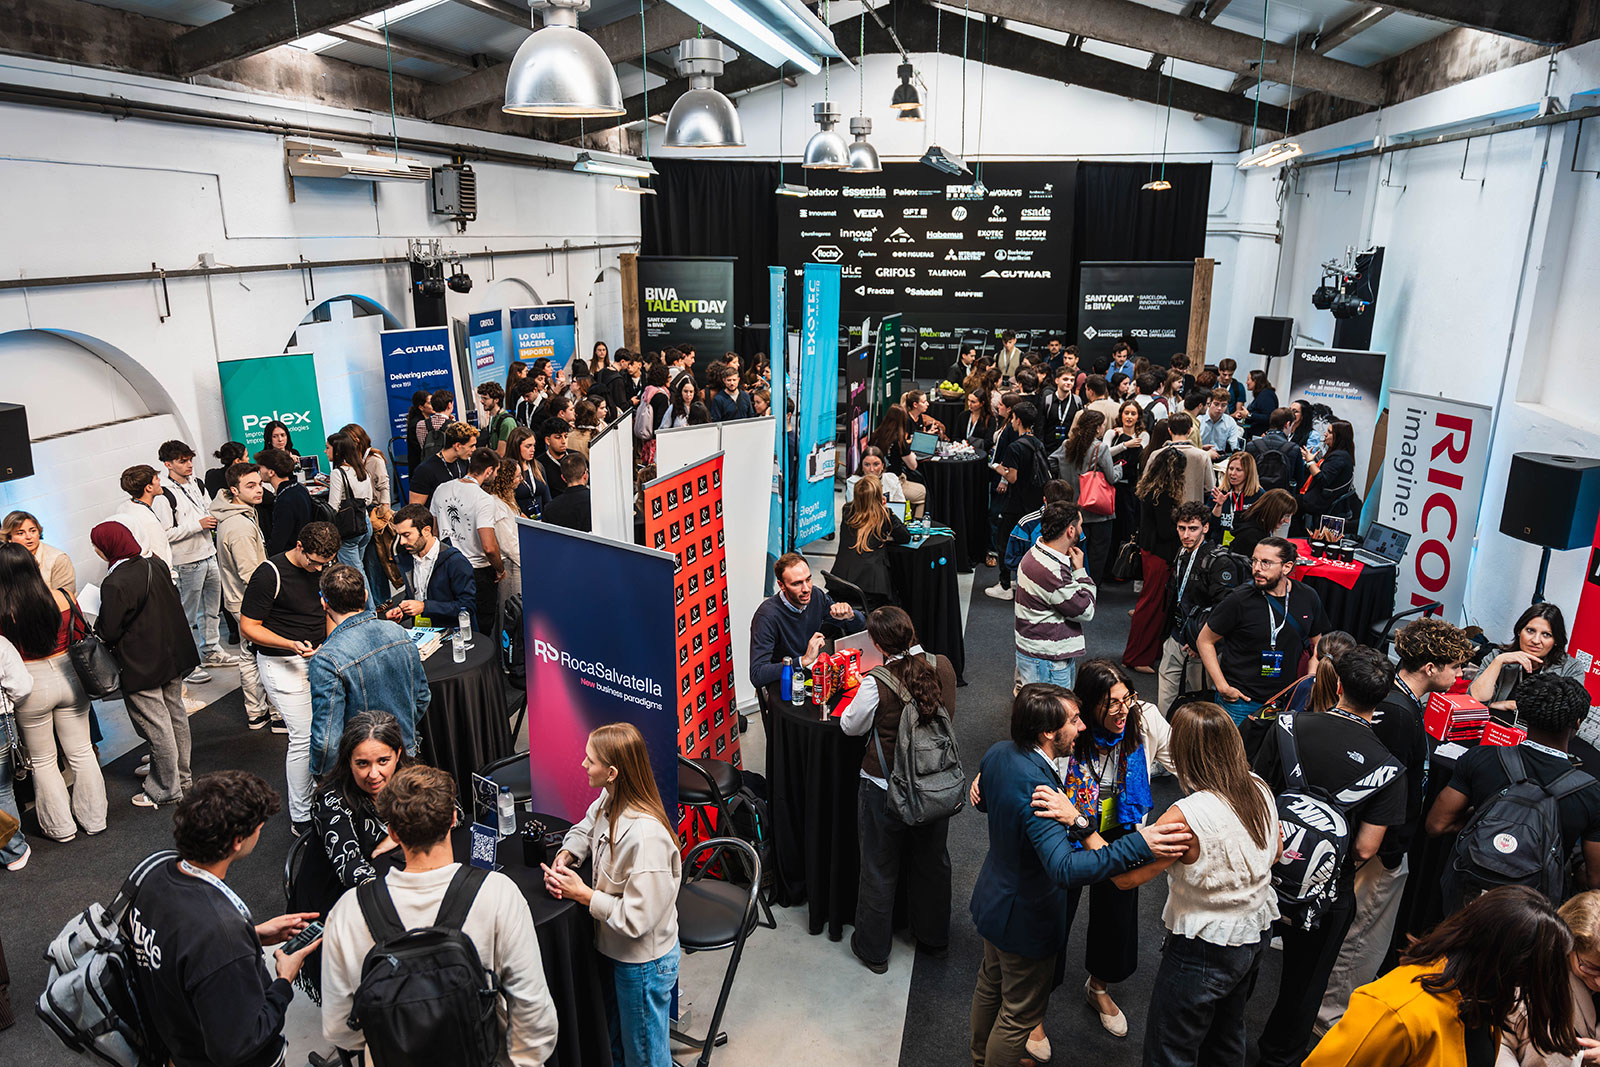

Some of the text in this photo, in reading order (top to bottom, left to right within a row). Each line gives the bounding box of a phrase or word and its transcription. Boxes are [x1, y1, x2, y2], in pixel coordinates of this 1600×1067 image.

[808, 188, 838, 196] edarbor
[1021, 206, 1051, 216] esade
[926, 231, 963, 239] Habemus
[875, 268, 916, 277] GRIFOLS
[645, 288, 678, 300] BIVA
[910, 288, 943, 296] Sabadell
[645, 300, 727, 313] TALENTDAY
[520, 339, 554, 348] HACEMOS
[405, 344, 444, 354] GUTMAR
[520, 348, 552, 357] IMPORTA
[1306, 354, 1336, 363] Sabadell
[390, 368, 448, 380] Delivering precision
[242, 410, 311, 430] Palex
[1392, 407, 1427, 522] imagine.
[561, 651, 662, 697] RocaSalvatella
[580, 678, 662, 710] New business paradigms
